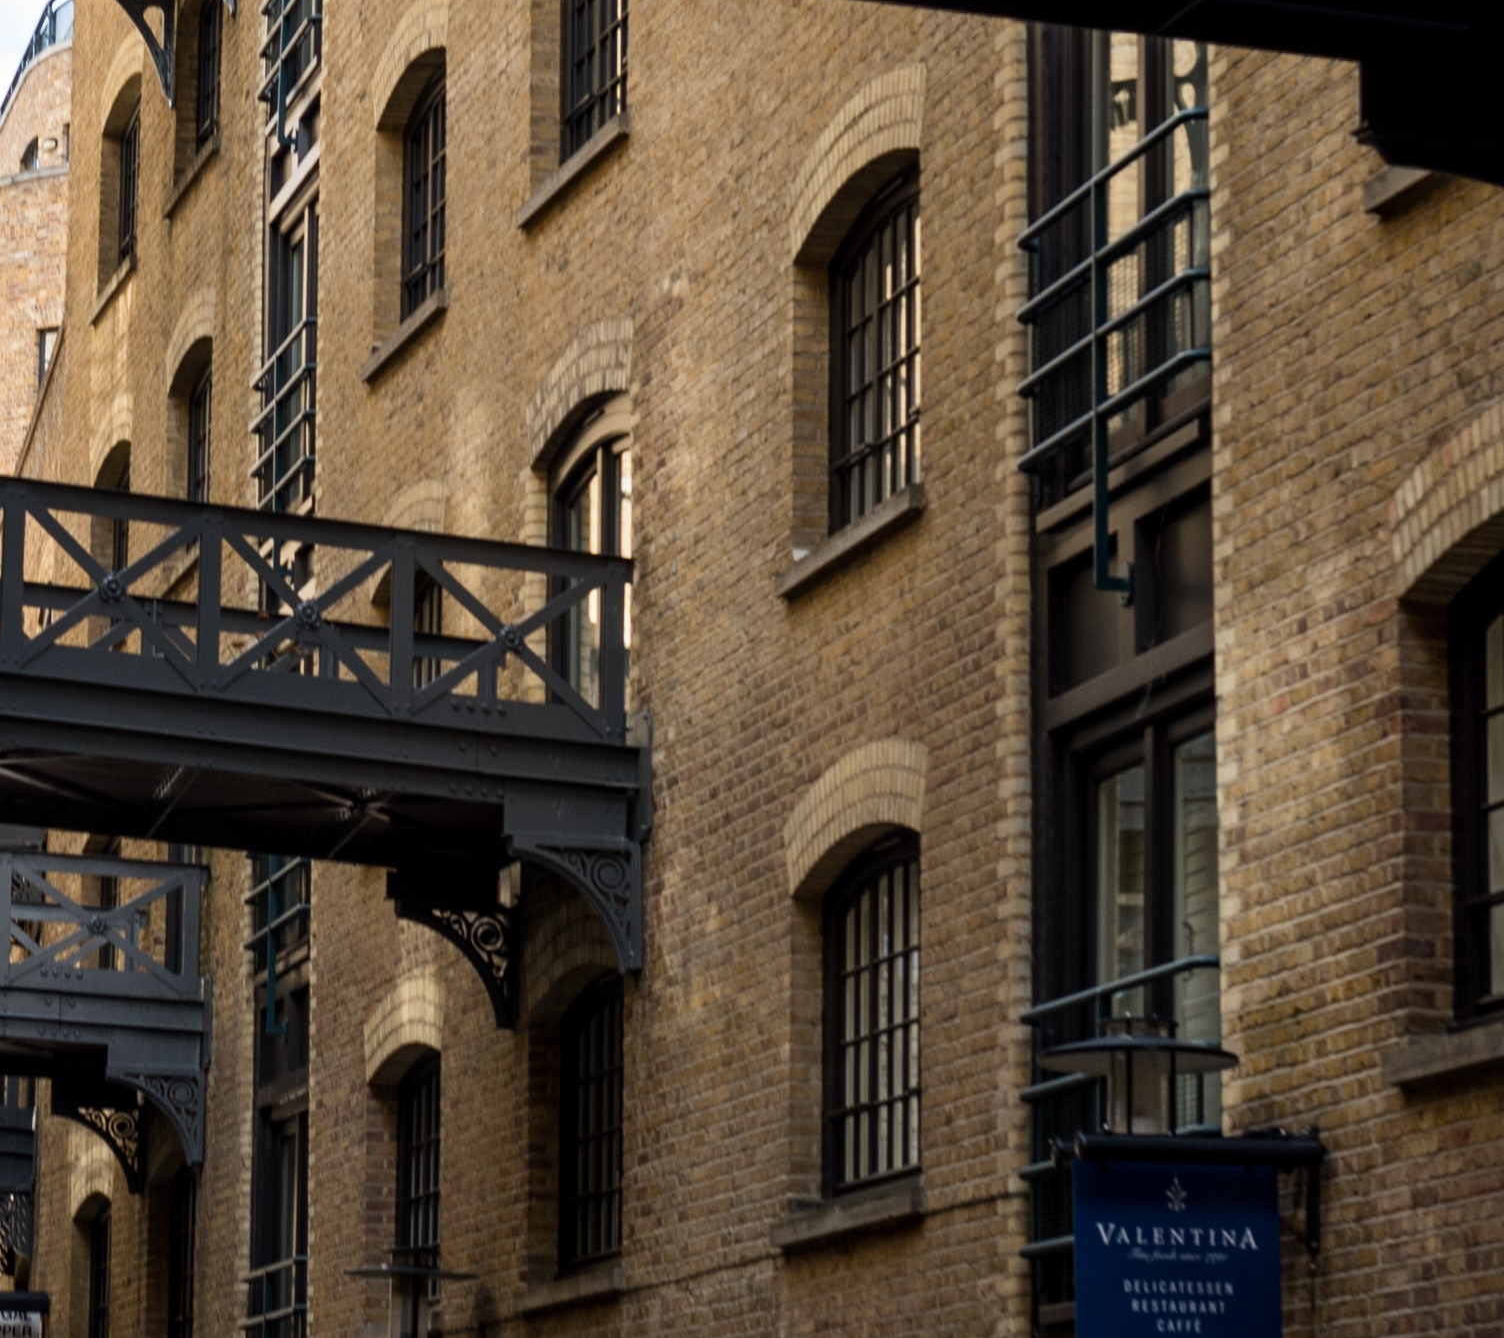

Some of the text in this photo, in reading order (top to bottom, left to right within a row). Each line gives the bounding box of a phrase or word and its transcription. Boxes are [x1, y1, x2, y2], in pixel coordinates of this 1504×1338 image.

[1096, 1222, 1259, 1250] VALENTINA
[1123, 1278, 1234, 1296] DELICATESSEN
[1130, 1298, 1226, 1314] RESTAURANT
